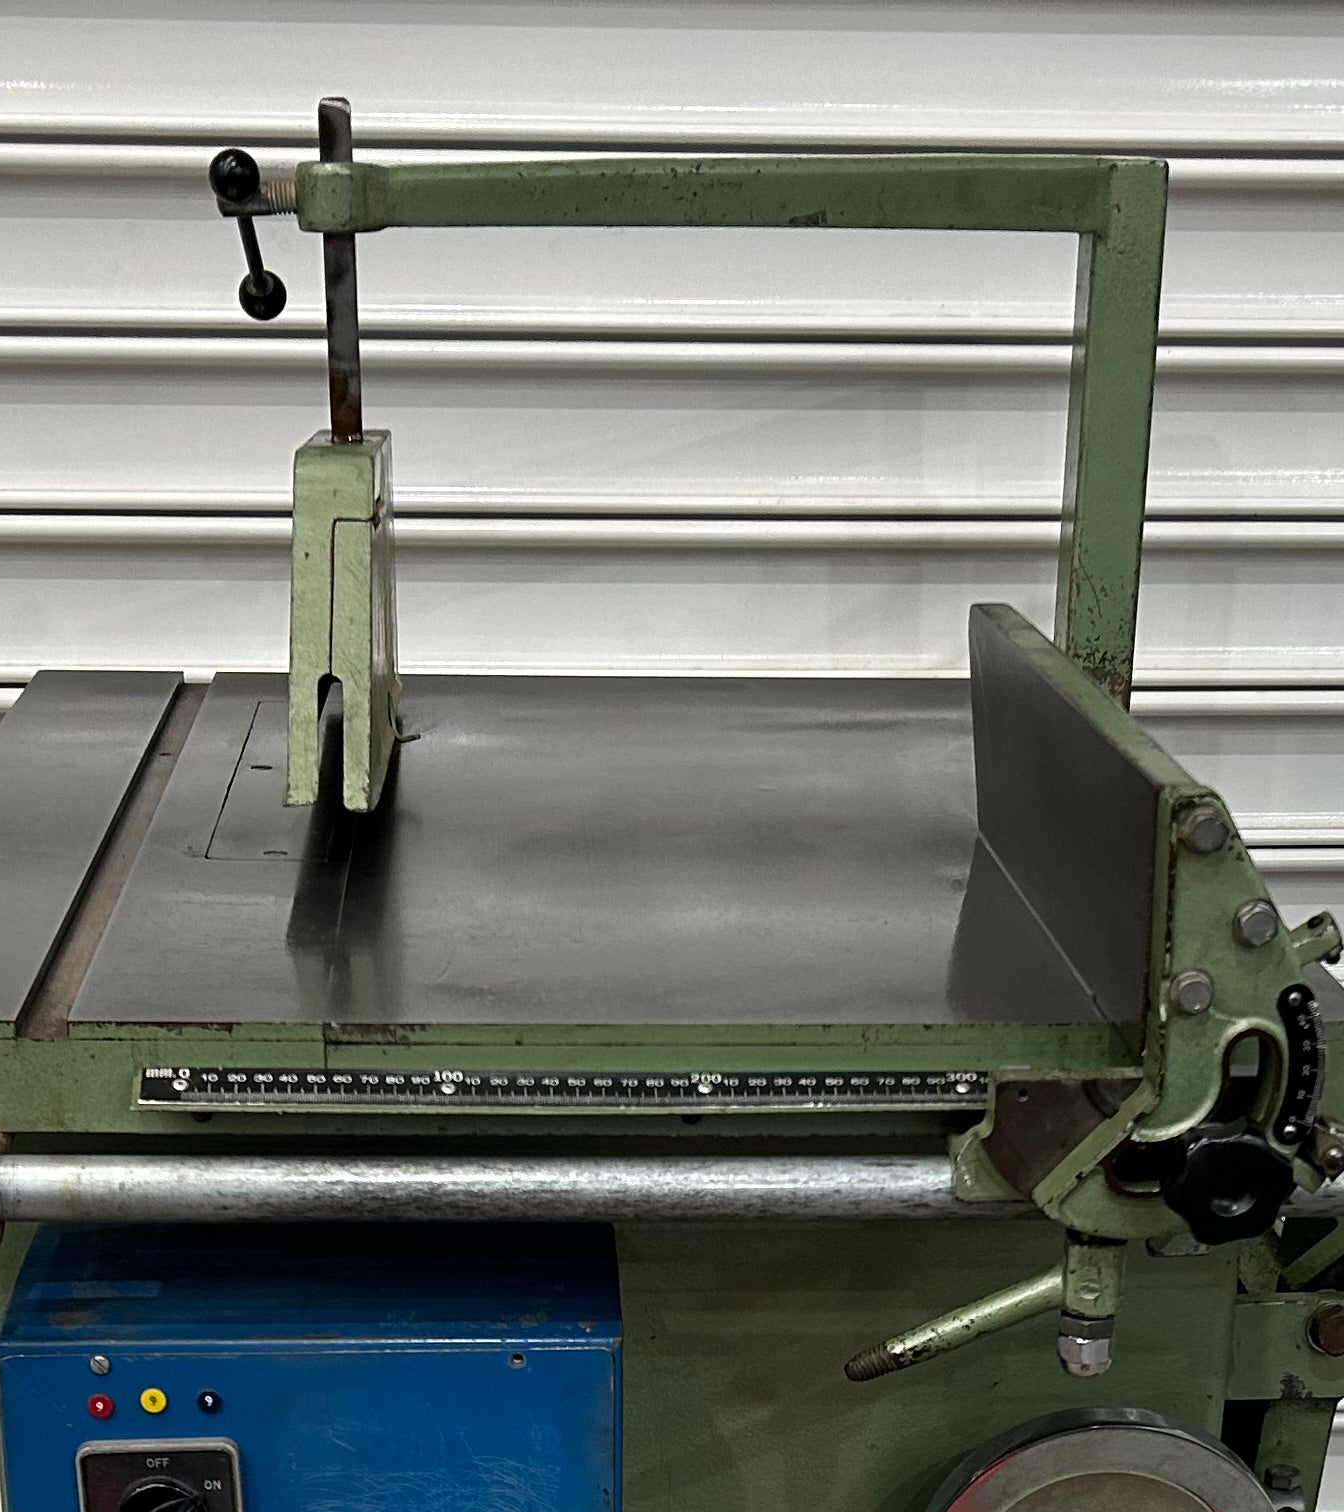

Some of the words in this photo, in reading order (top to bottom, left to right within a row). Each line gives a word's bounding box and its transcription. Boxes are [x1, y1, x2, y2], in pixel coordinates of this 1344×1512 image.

[201, 1072, 219, 1083] 10
[433, 1070, 464, 1083] 100
[690, 1072, 722, 1084] 200
[945, 1072, 978, 1083] 300
[146, 1457, 170, 1469] OFF
[203, 1479, 222, 1490] ON
